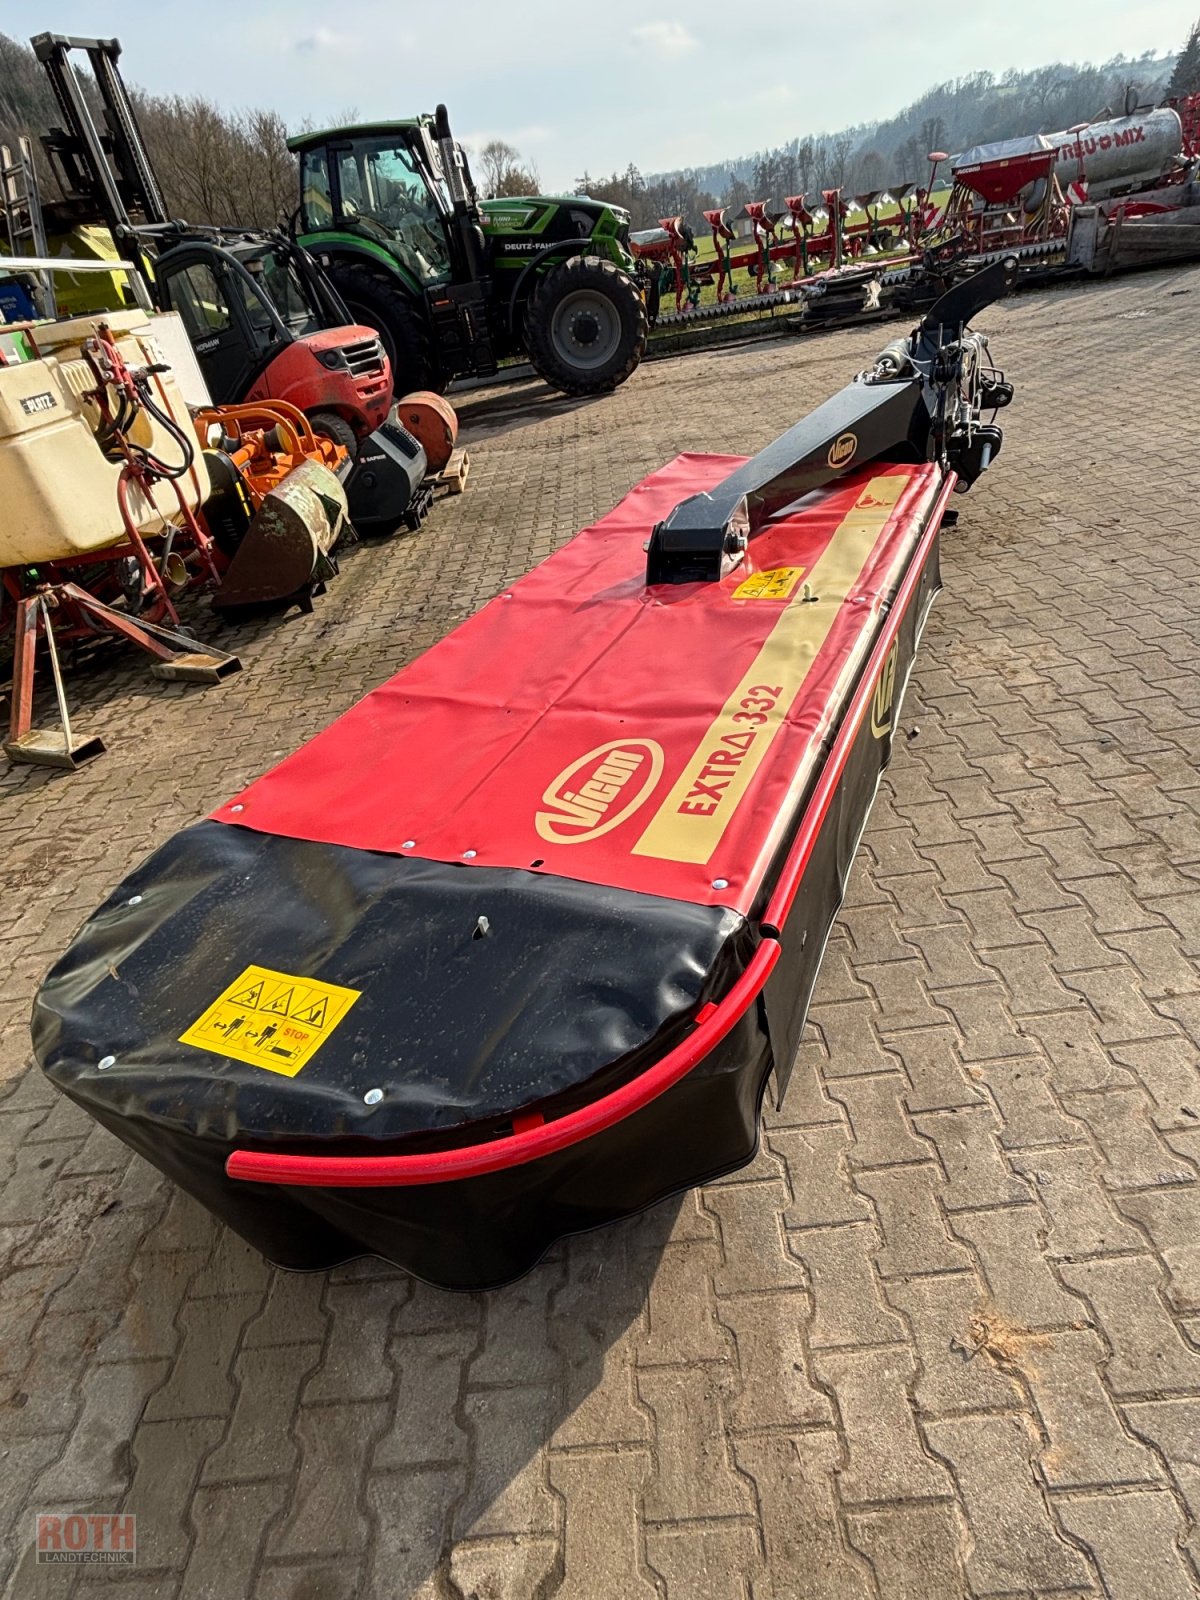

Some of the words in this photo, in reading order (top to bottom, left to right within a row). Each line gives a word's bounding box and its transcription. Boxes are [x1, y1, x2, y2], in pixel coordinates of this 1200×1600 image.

[829, 436, 856, 466] Vicon
[732, 685, 784, 726] 332
[535, 741, 656, 837] Vicon
[282, 1027, 310, 1042] STOP
